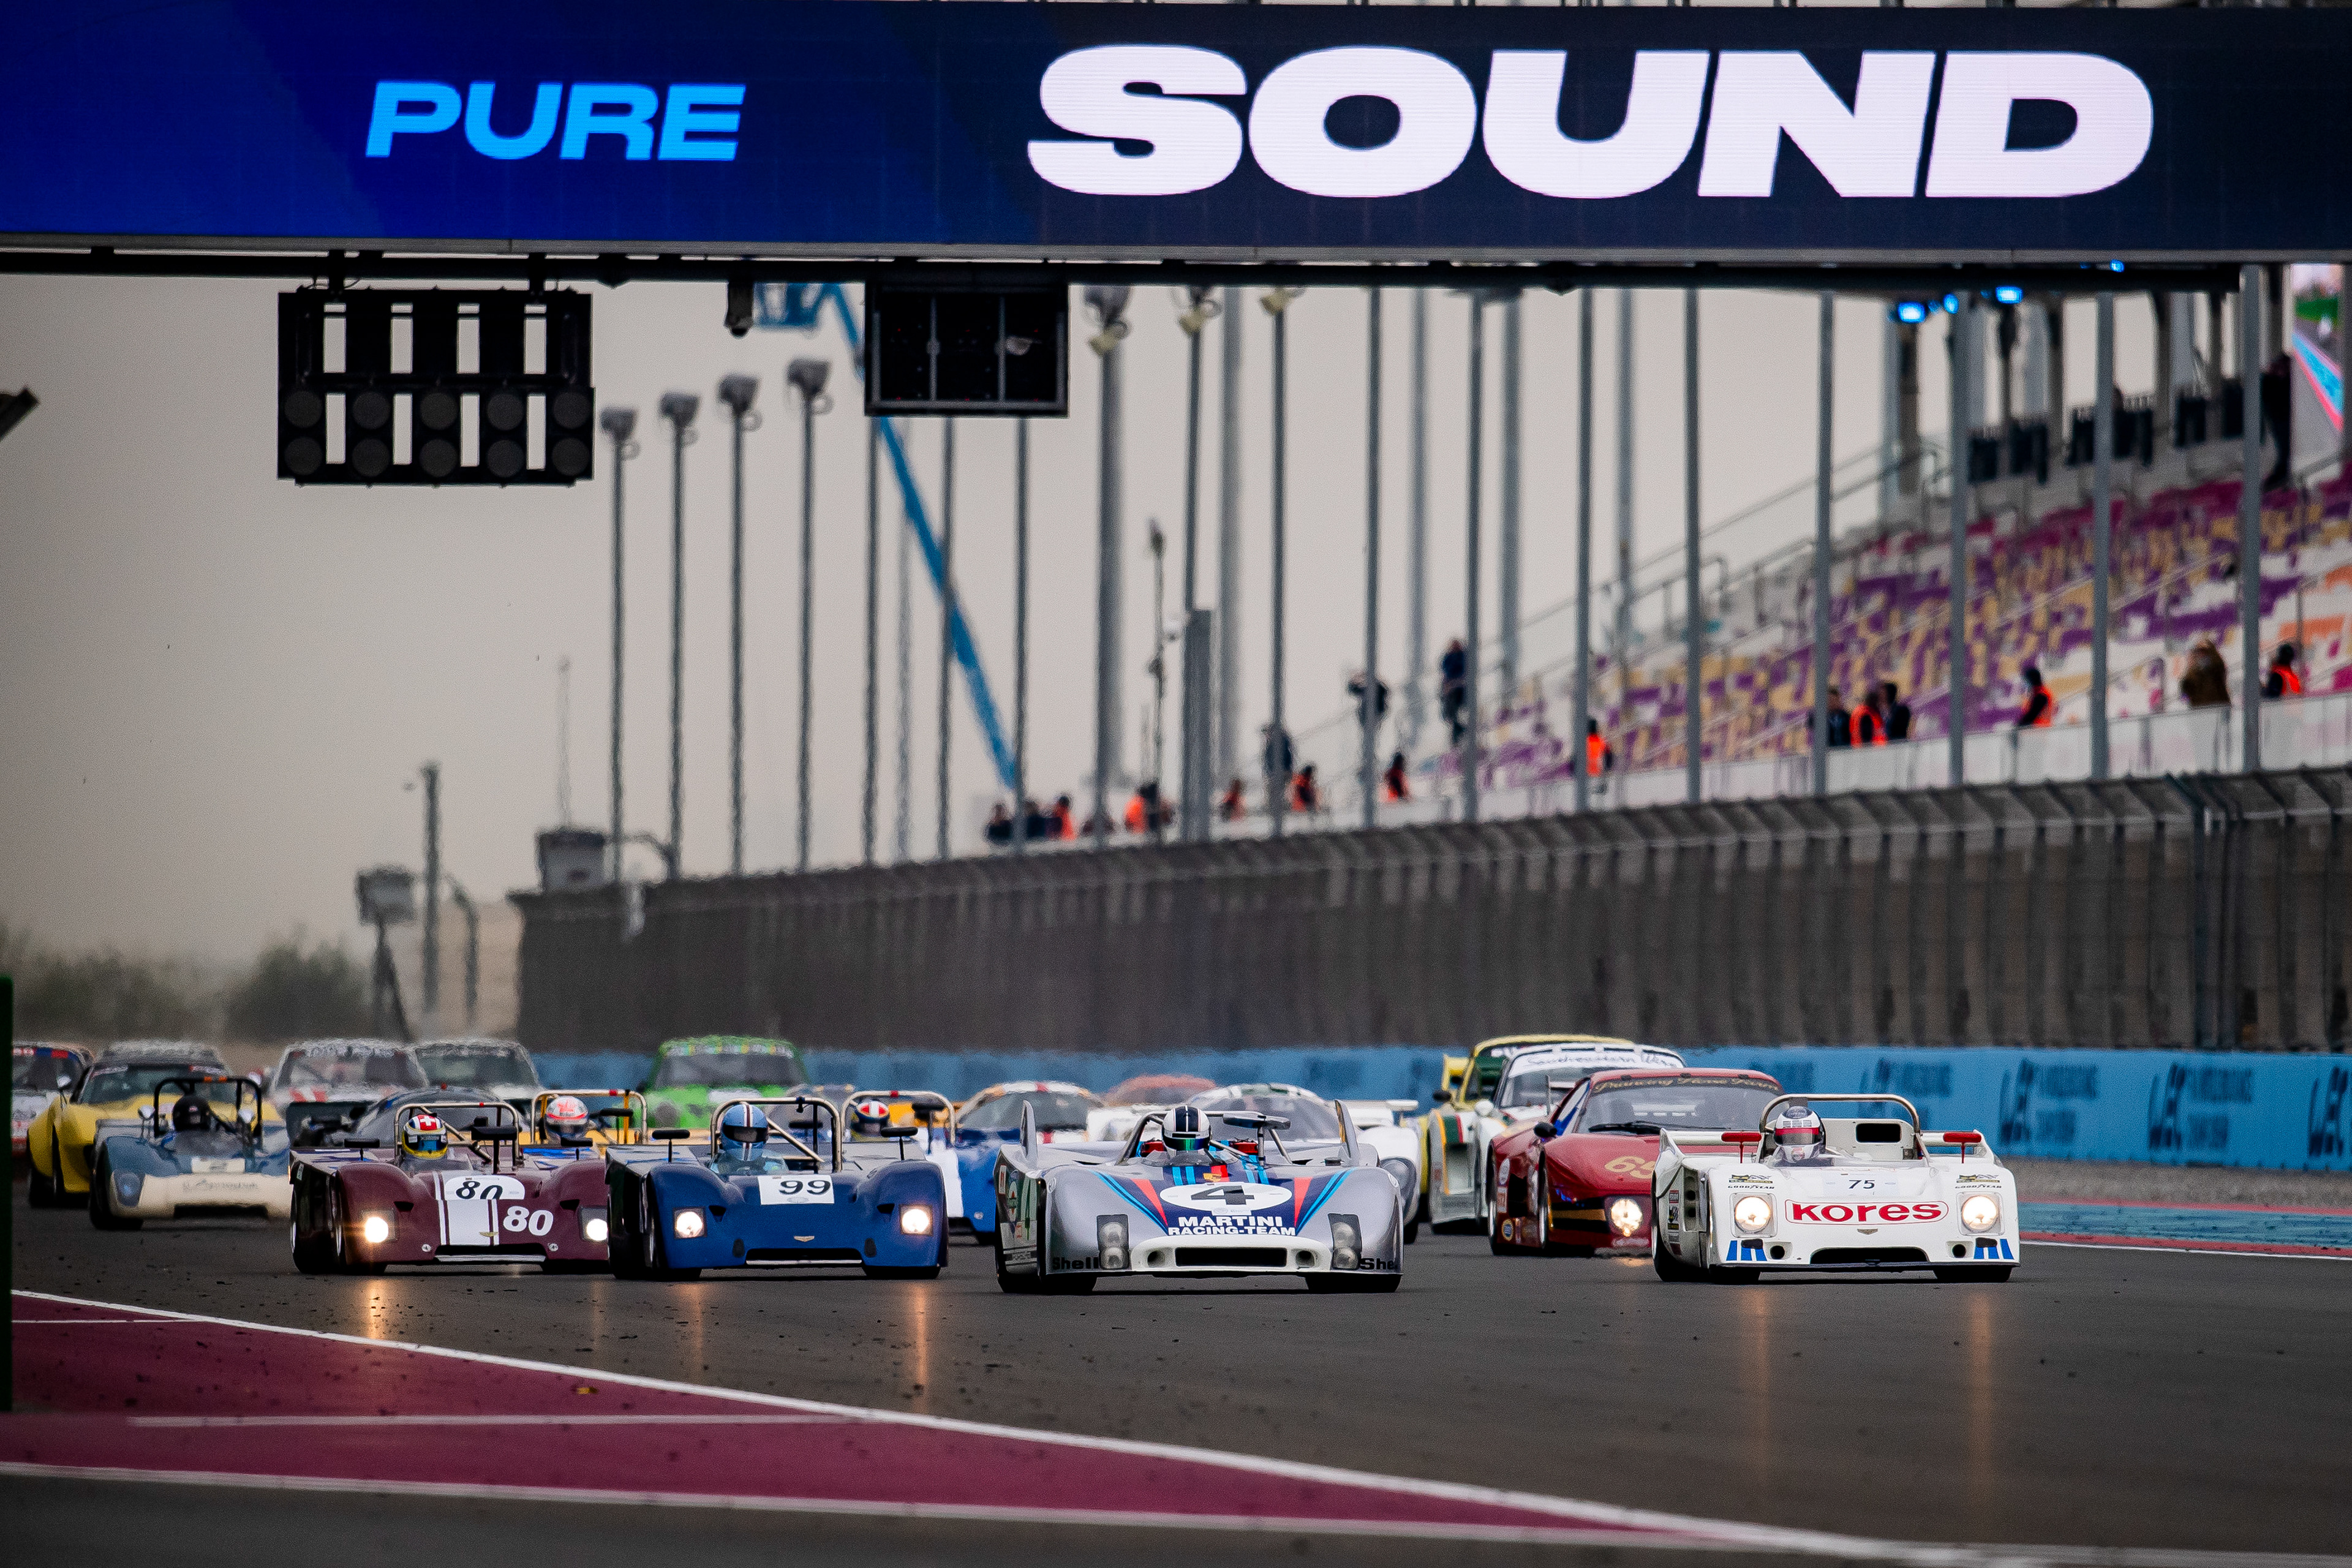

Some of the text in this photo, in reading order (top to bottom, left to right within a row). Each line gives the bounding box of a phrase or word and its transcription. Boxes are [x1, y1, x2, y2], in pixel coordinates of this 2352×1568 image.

[365, 81, 747, 161] PURE
[1027, 44, 2154, 199] SOUND
[456, 1180, 503, 1200] 80
[778, 1179, 831, 1196] 99
[1849, 1180, 1875, 1189] 75
[1191, 1185, 1255, 1205] 4
[503, 1206, 554, 1236] 80
[1178, 1216, 1283, 1227] MARTINI
[1167, 1226, 1296, 1236] RACING-TEAM
[1052, 1257, 1099, 1270] Shell
[1359, 1257, 1398, 1270] She
